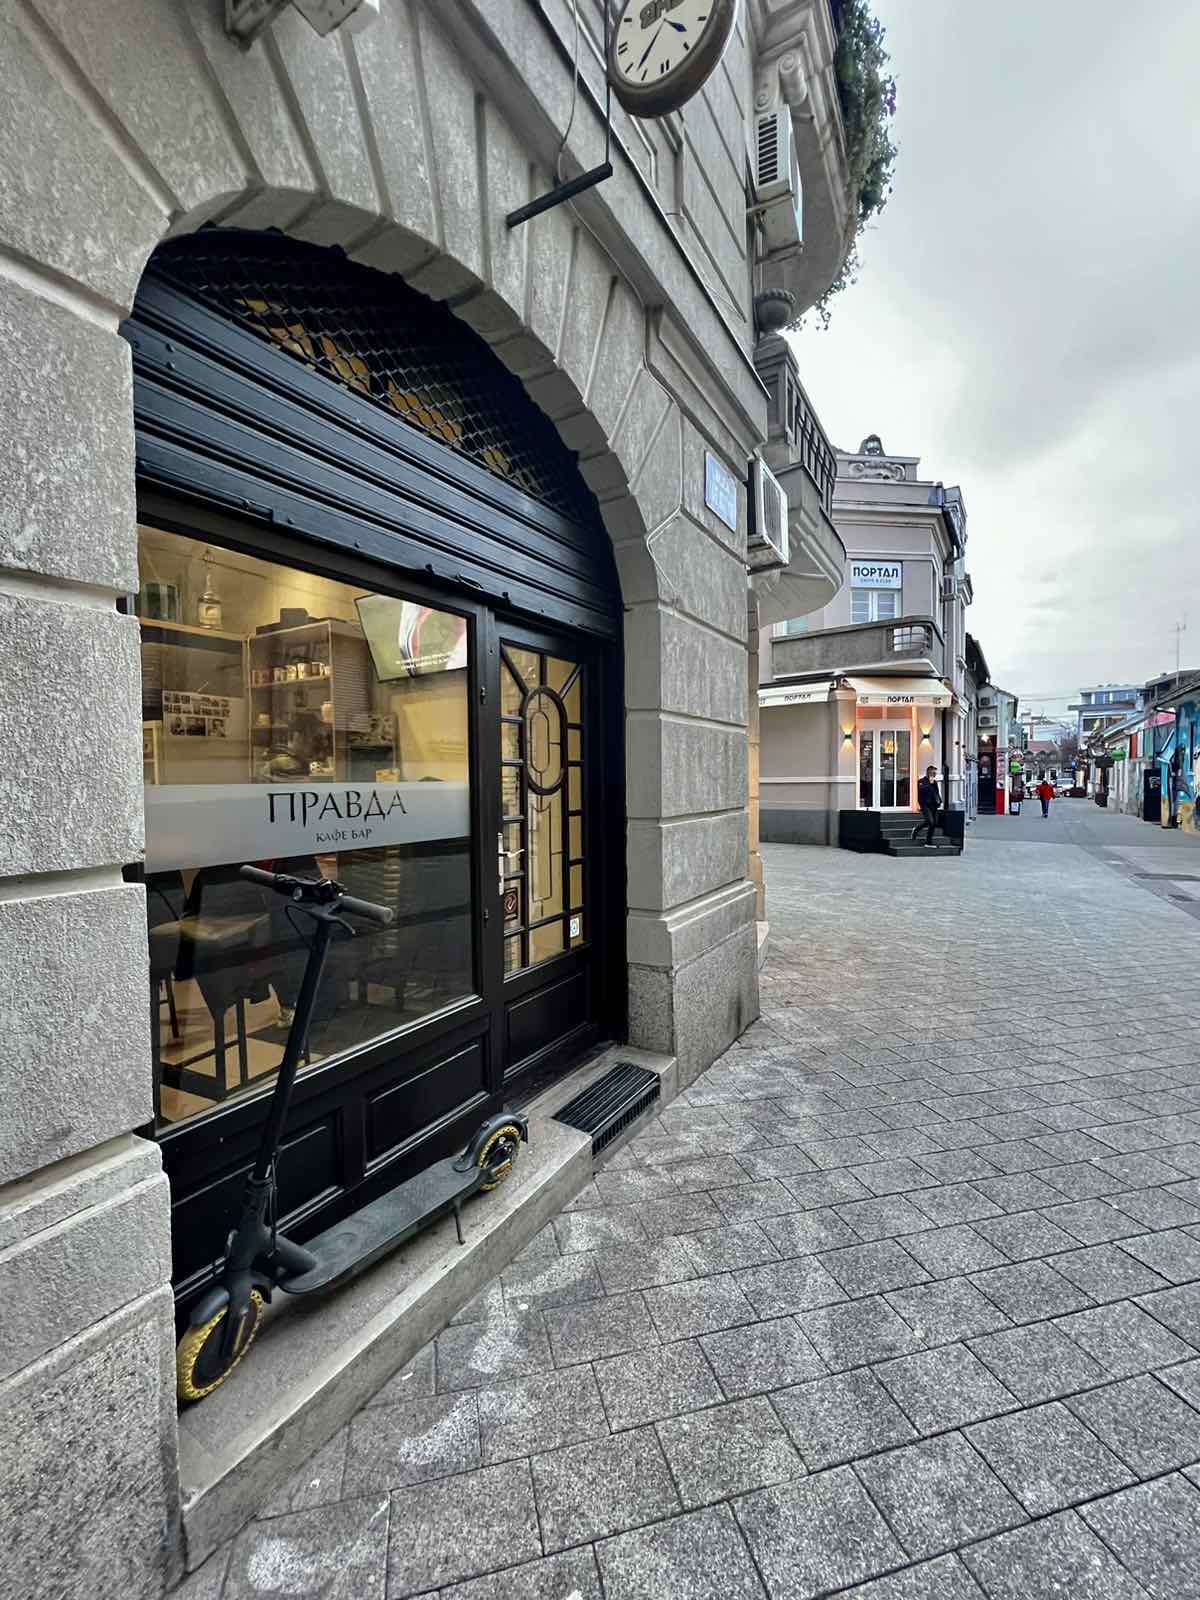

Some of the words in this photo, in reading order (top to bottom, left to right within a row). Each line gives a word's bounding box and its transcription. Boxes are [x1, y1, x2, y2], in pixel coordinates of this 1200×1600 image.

[853, 567, 899, 578] ПОРТАЛ
[267, 790, 407, 828] ПРАВДА
[315, 829, 349, 843] КАФЕ
[351, 828, 373, 840] БАР
